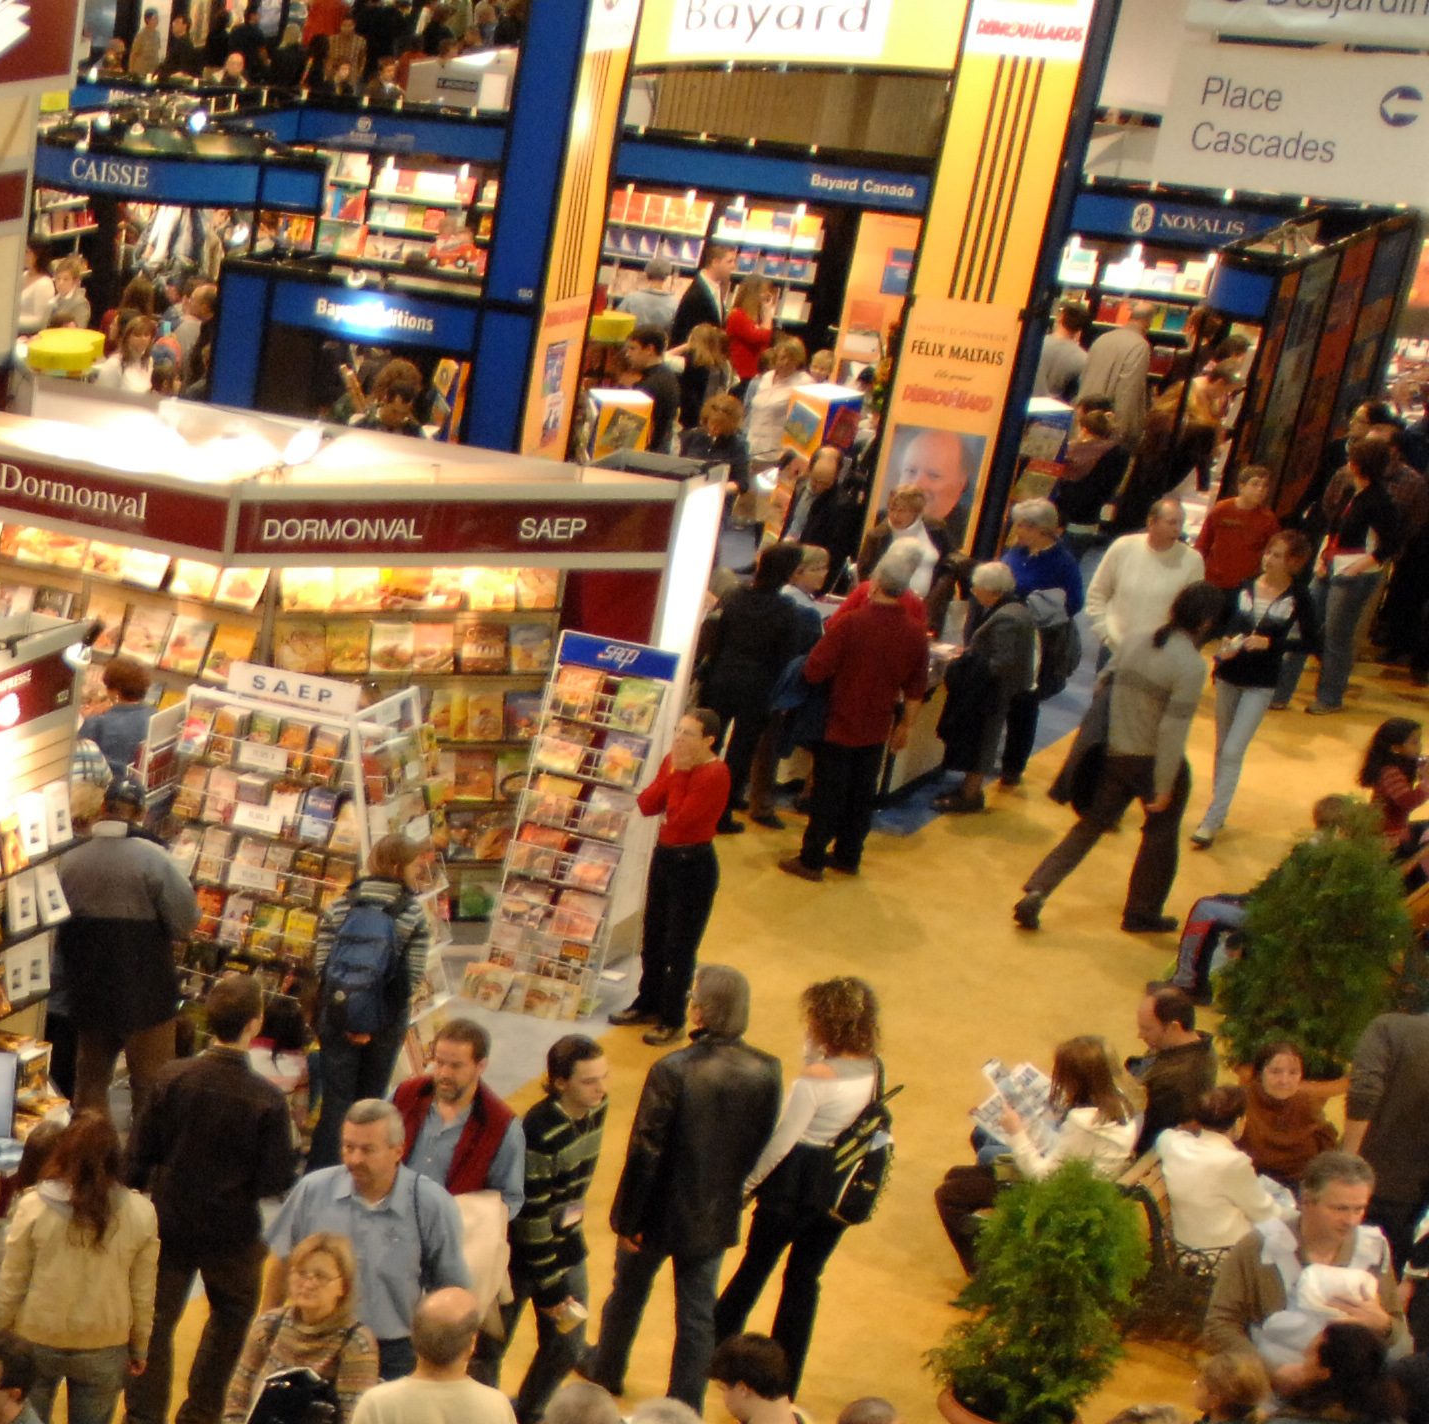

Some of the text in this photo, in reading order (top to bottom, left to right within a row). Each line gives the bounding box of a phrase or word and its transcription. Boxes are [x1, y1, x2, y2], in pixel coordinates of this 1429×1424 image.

[1201, 76, 1283, 112] Place
[1191, 122, 1337, 163] Cascades
[70, 157, 149, 188] CAISSE
[810, 173, 915, 199] Bayard Canada
[1158, 212, 1246, 236] NOVALIS
[910, 338, 1005, 366] FÉLIX MALTAIS
[263, 516, 588, 541] DORMONVAL SAEP
